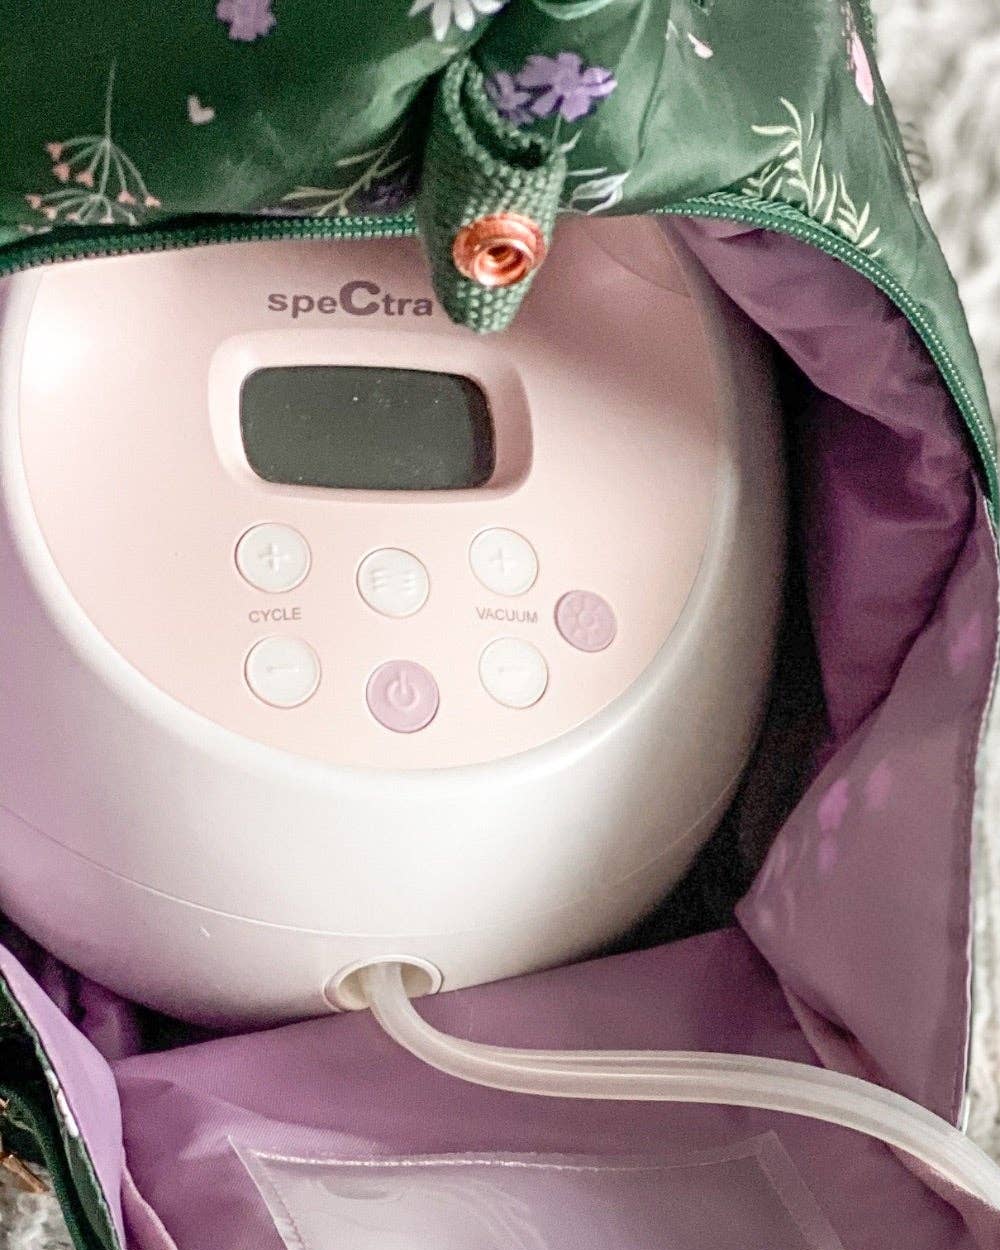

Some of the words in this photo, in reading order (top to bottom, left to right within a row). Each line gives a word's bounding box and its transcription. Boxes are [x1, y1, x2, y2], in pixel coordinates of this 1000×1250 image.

[267, 280, 433, 319] speCtra
[248, 607, 302, 624] CYCLE
[475, 606, 539, 624] VACUUM
